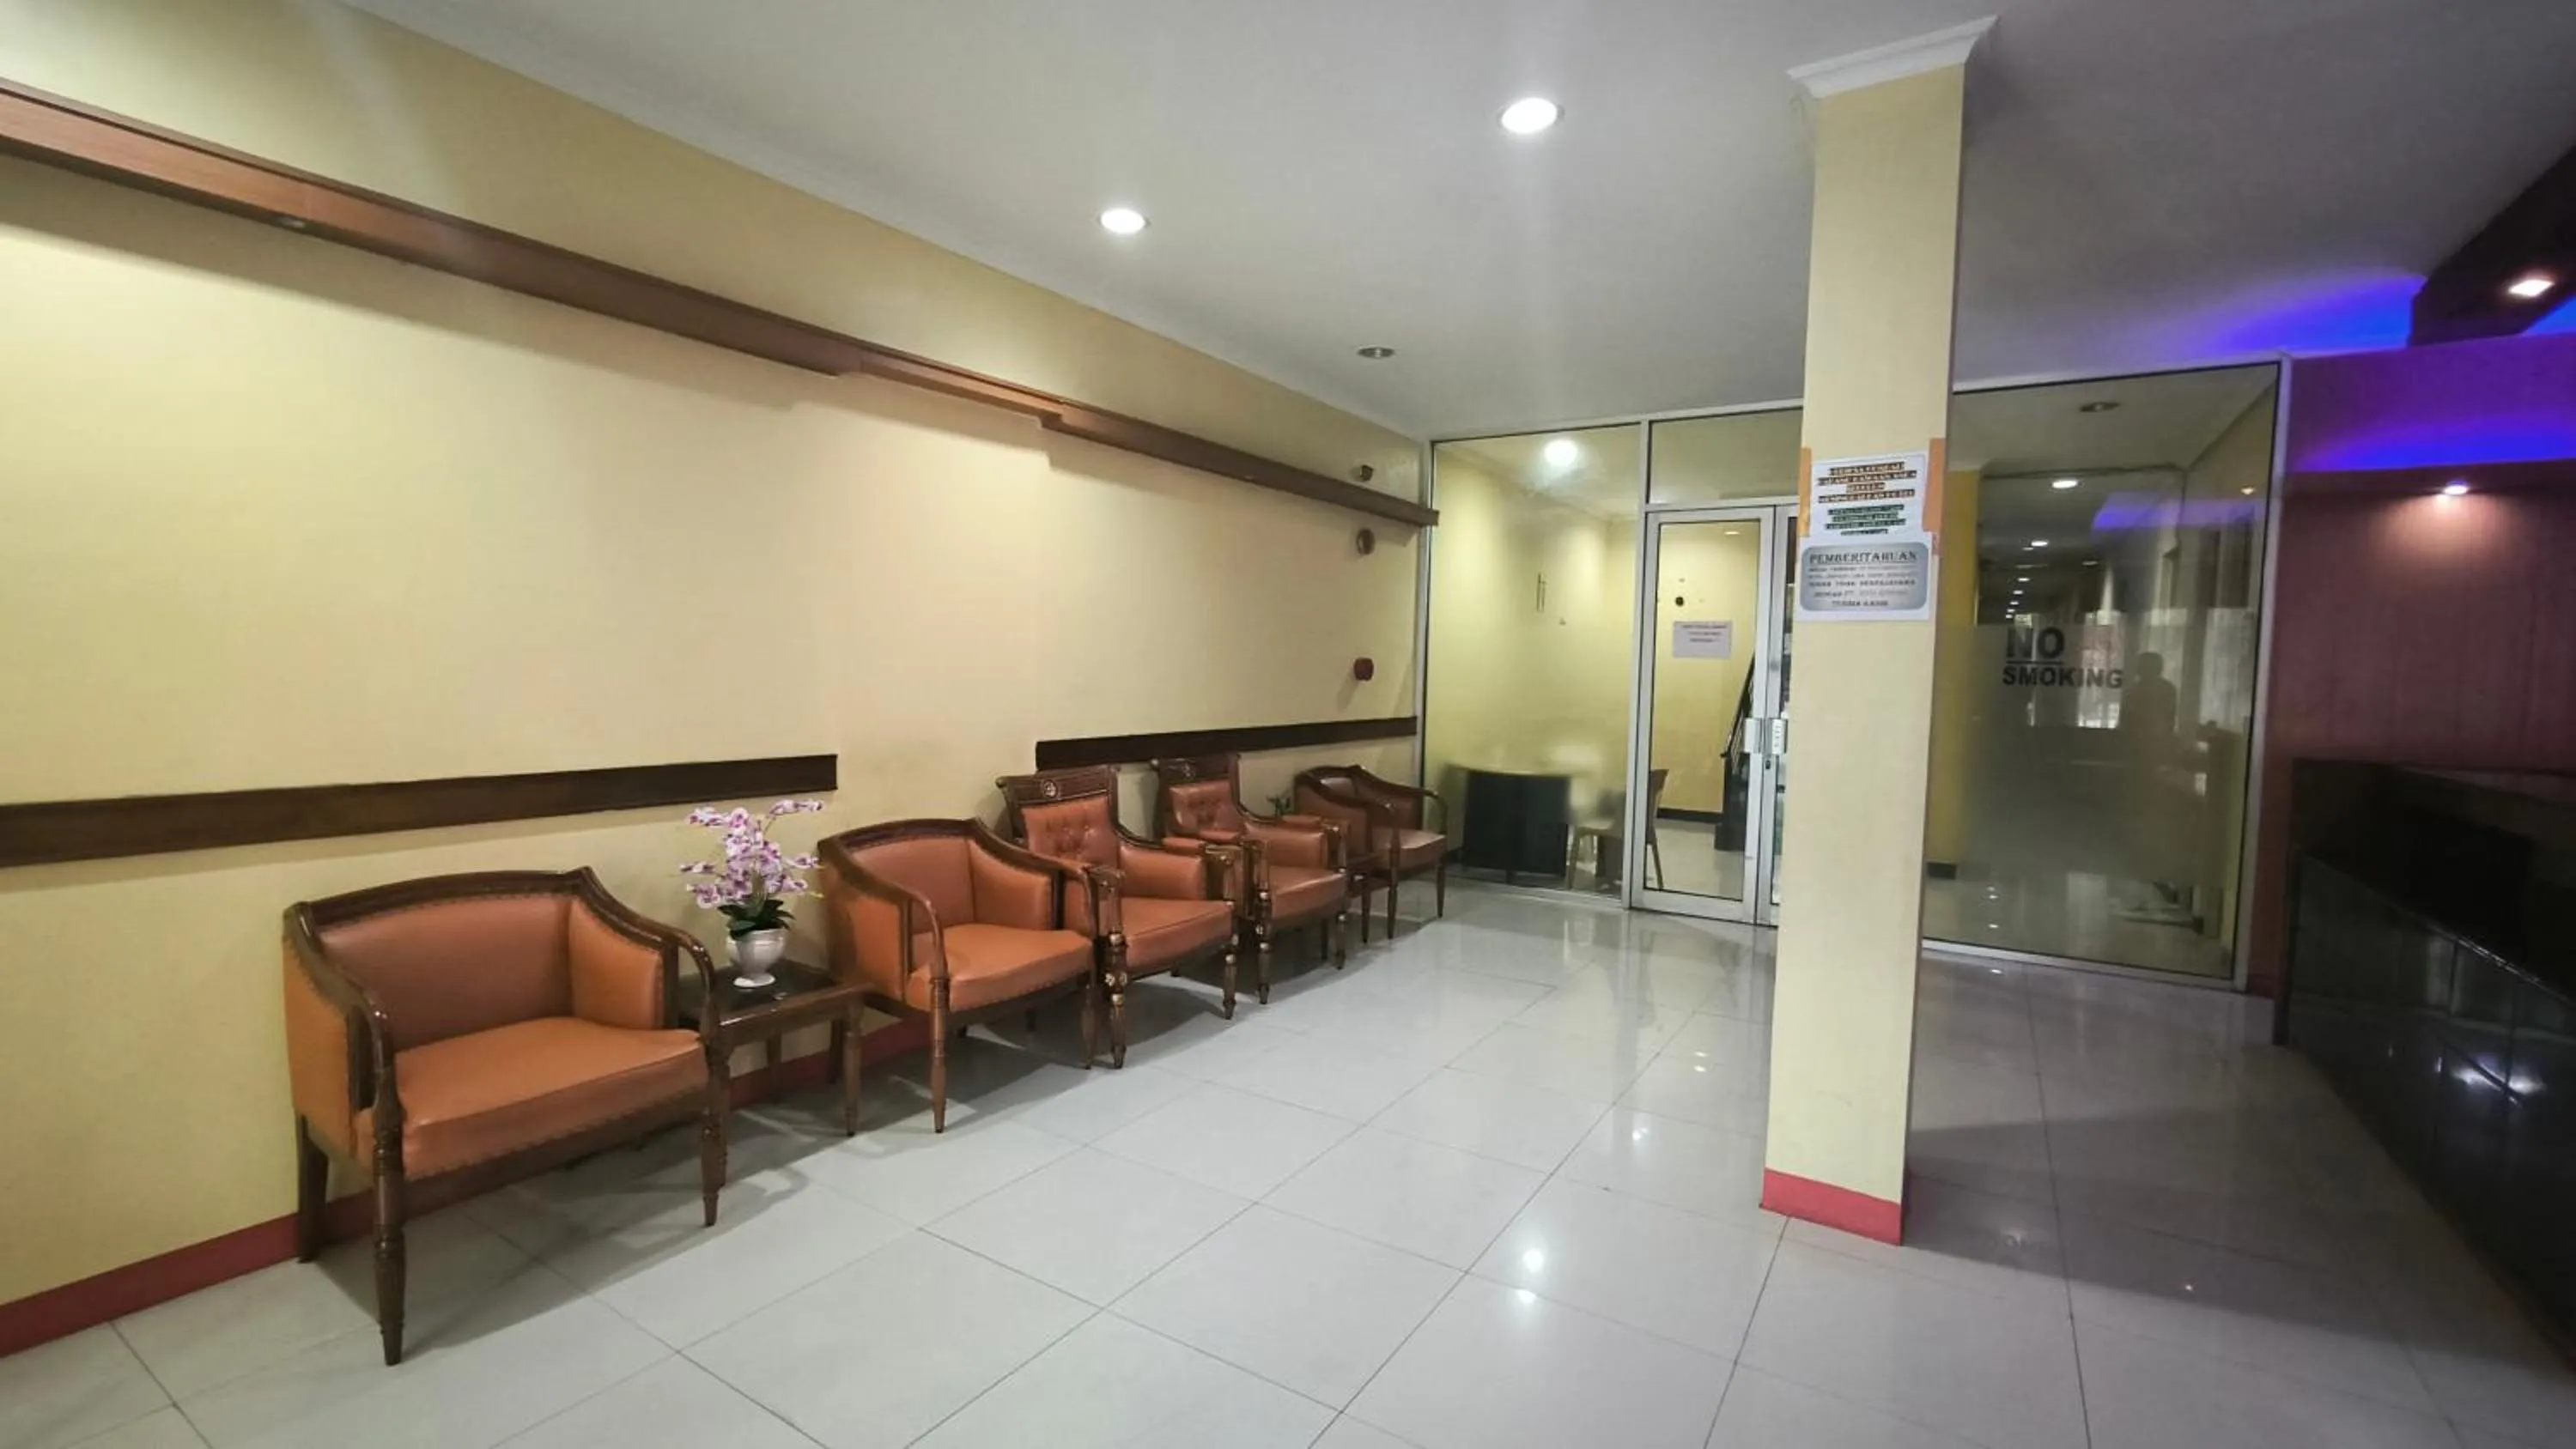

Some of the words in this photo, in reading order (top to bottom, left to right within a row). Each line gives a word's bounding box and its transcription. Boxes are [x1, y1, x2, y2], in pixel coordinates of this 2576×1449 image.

[1809, 550, 1917, 564] PEMBERITAHUAN
[2006, 627, 2065, 658] NO
[2002, 666, 2123, 689] SMOKING
